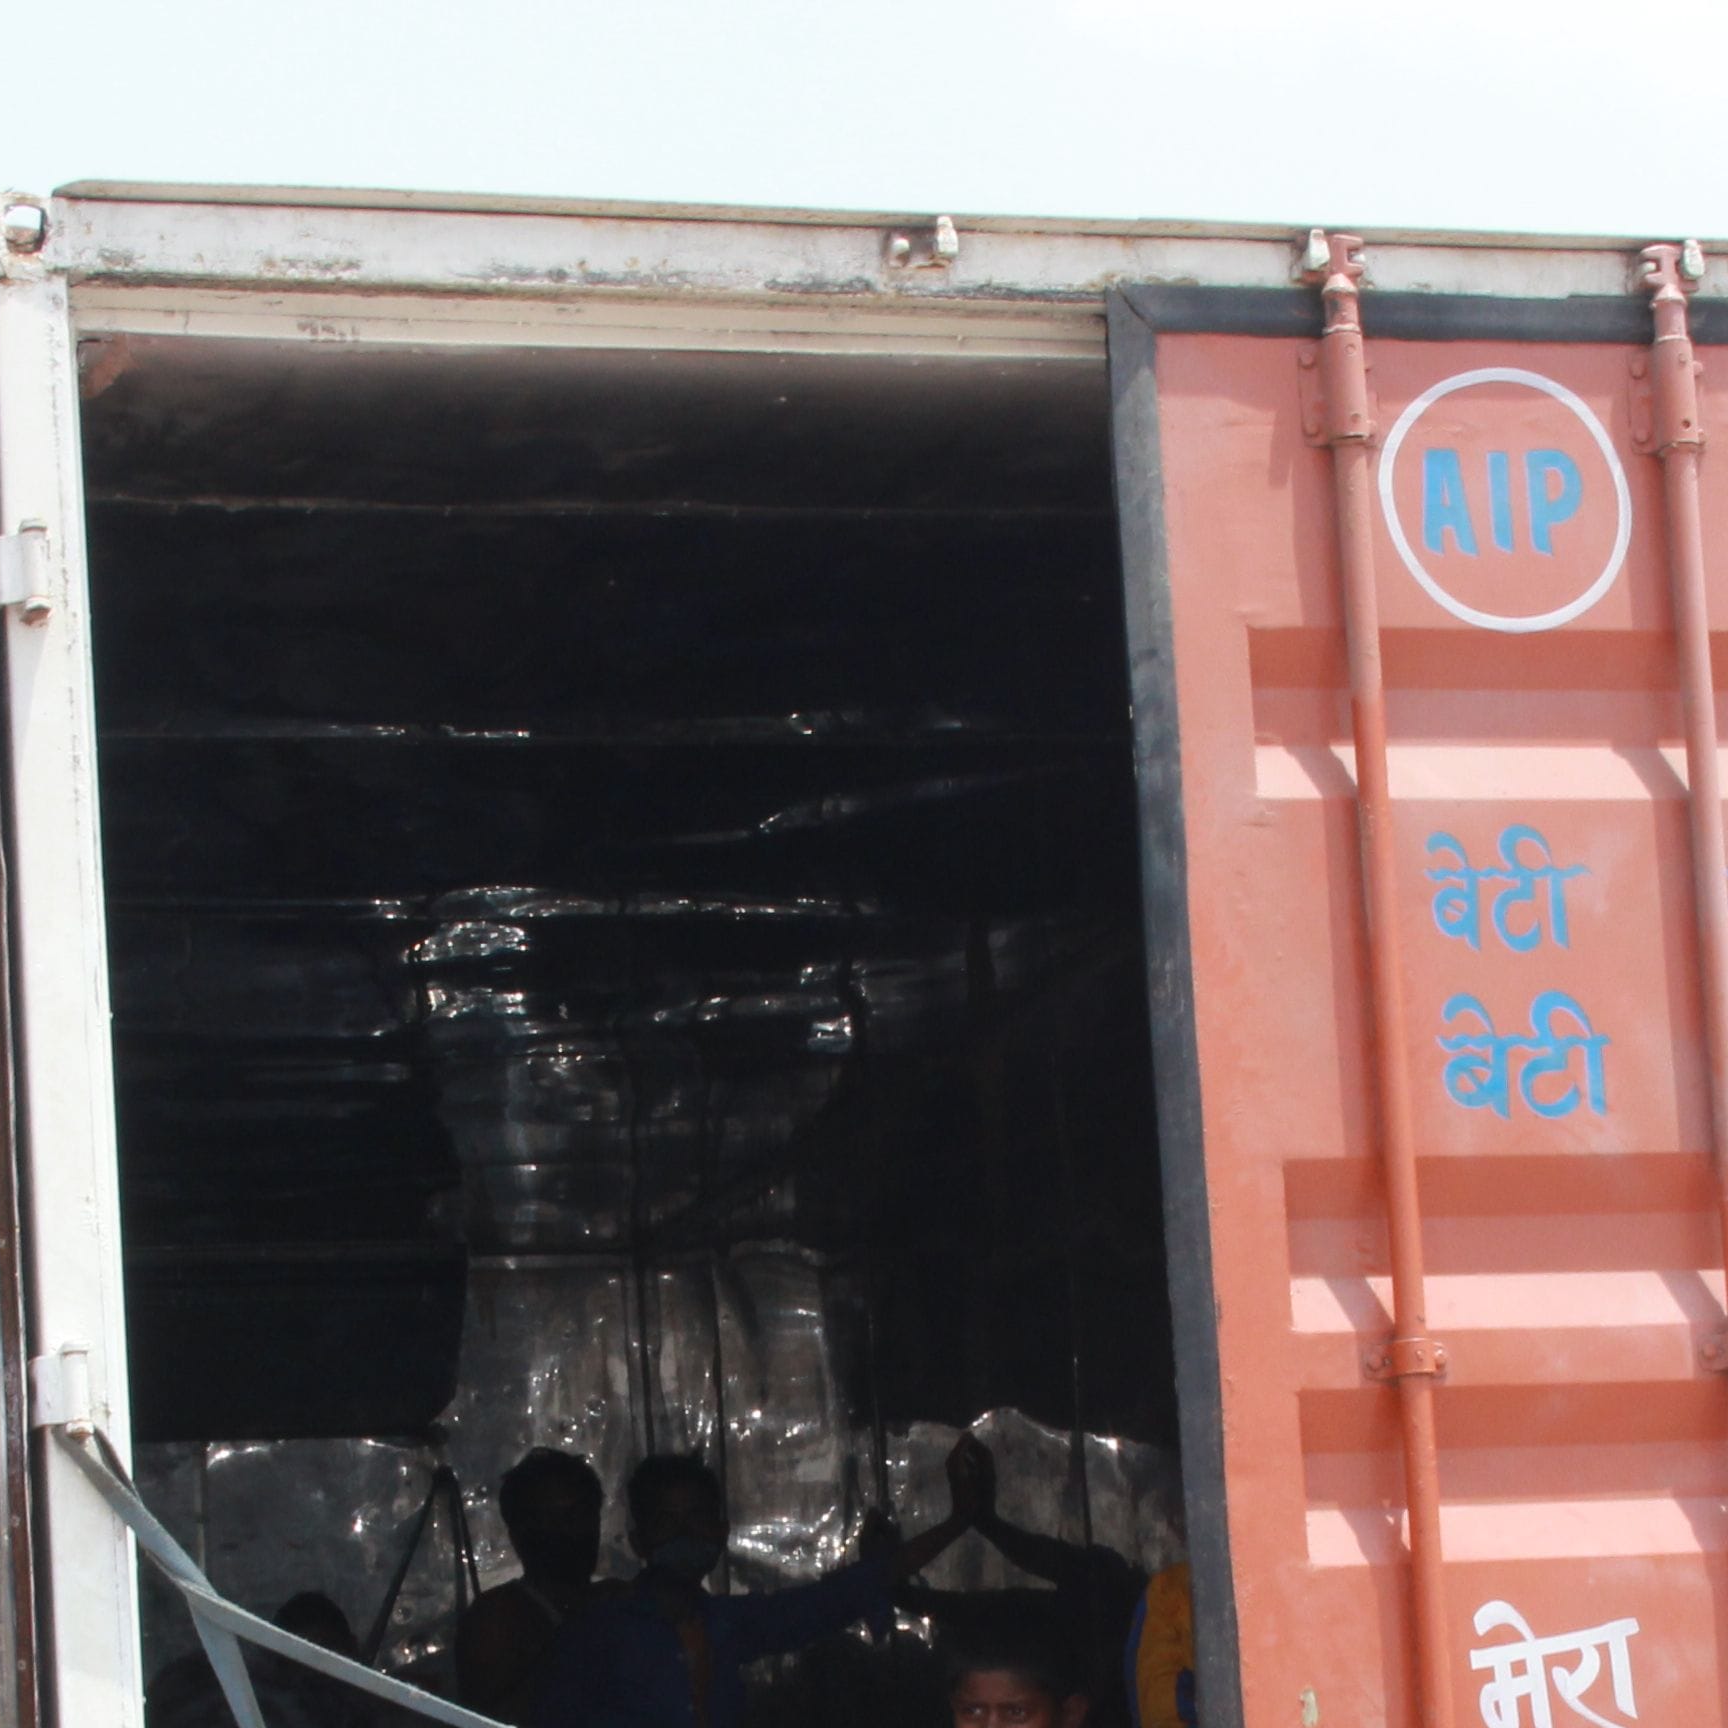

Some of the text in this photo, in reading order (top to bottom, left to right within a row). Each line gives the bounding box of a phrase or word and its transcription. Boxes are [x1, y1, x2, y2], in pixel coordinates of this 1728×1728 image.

[1423, 447, 1584, 557] AIP
[1425, 824, 1592, 954] बेटी
[1437, 988, 1611, 1121] बेटी
